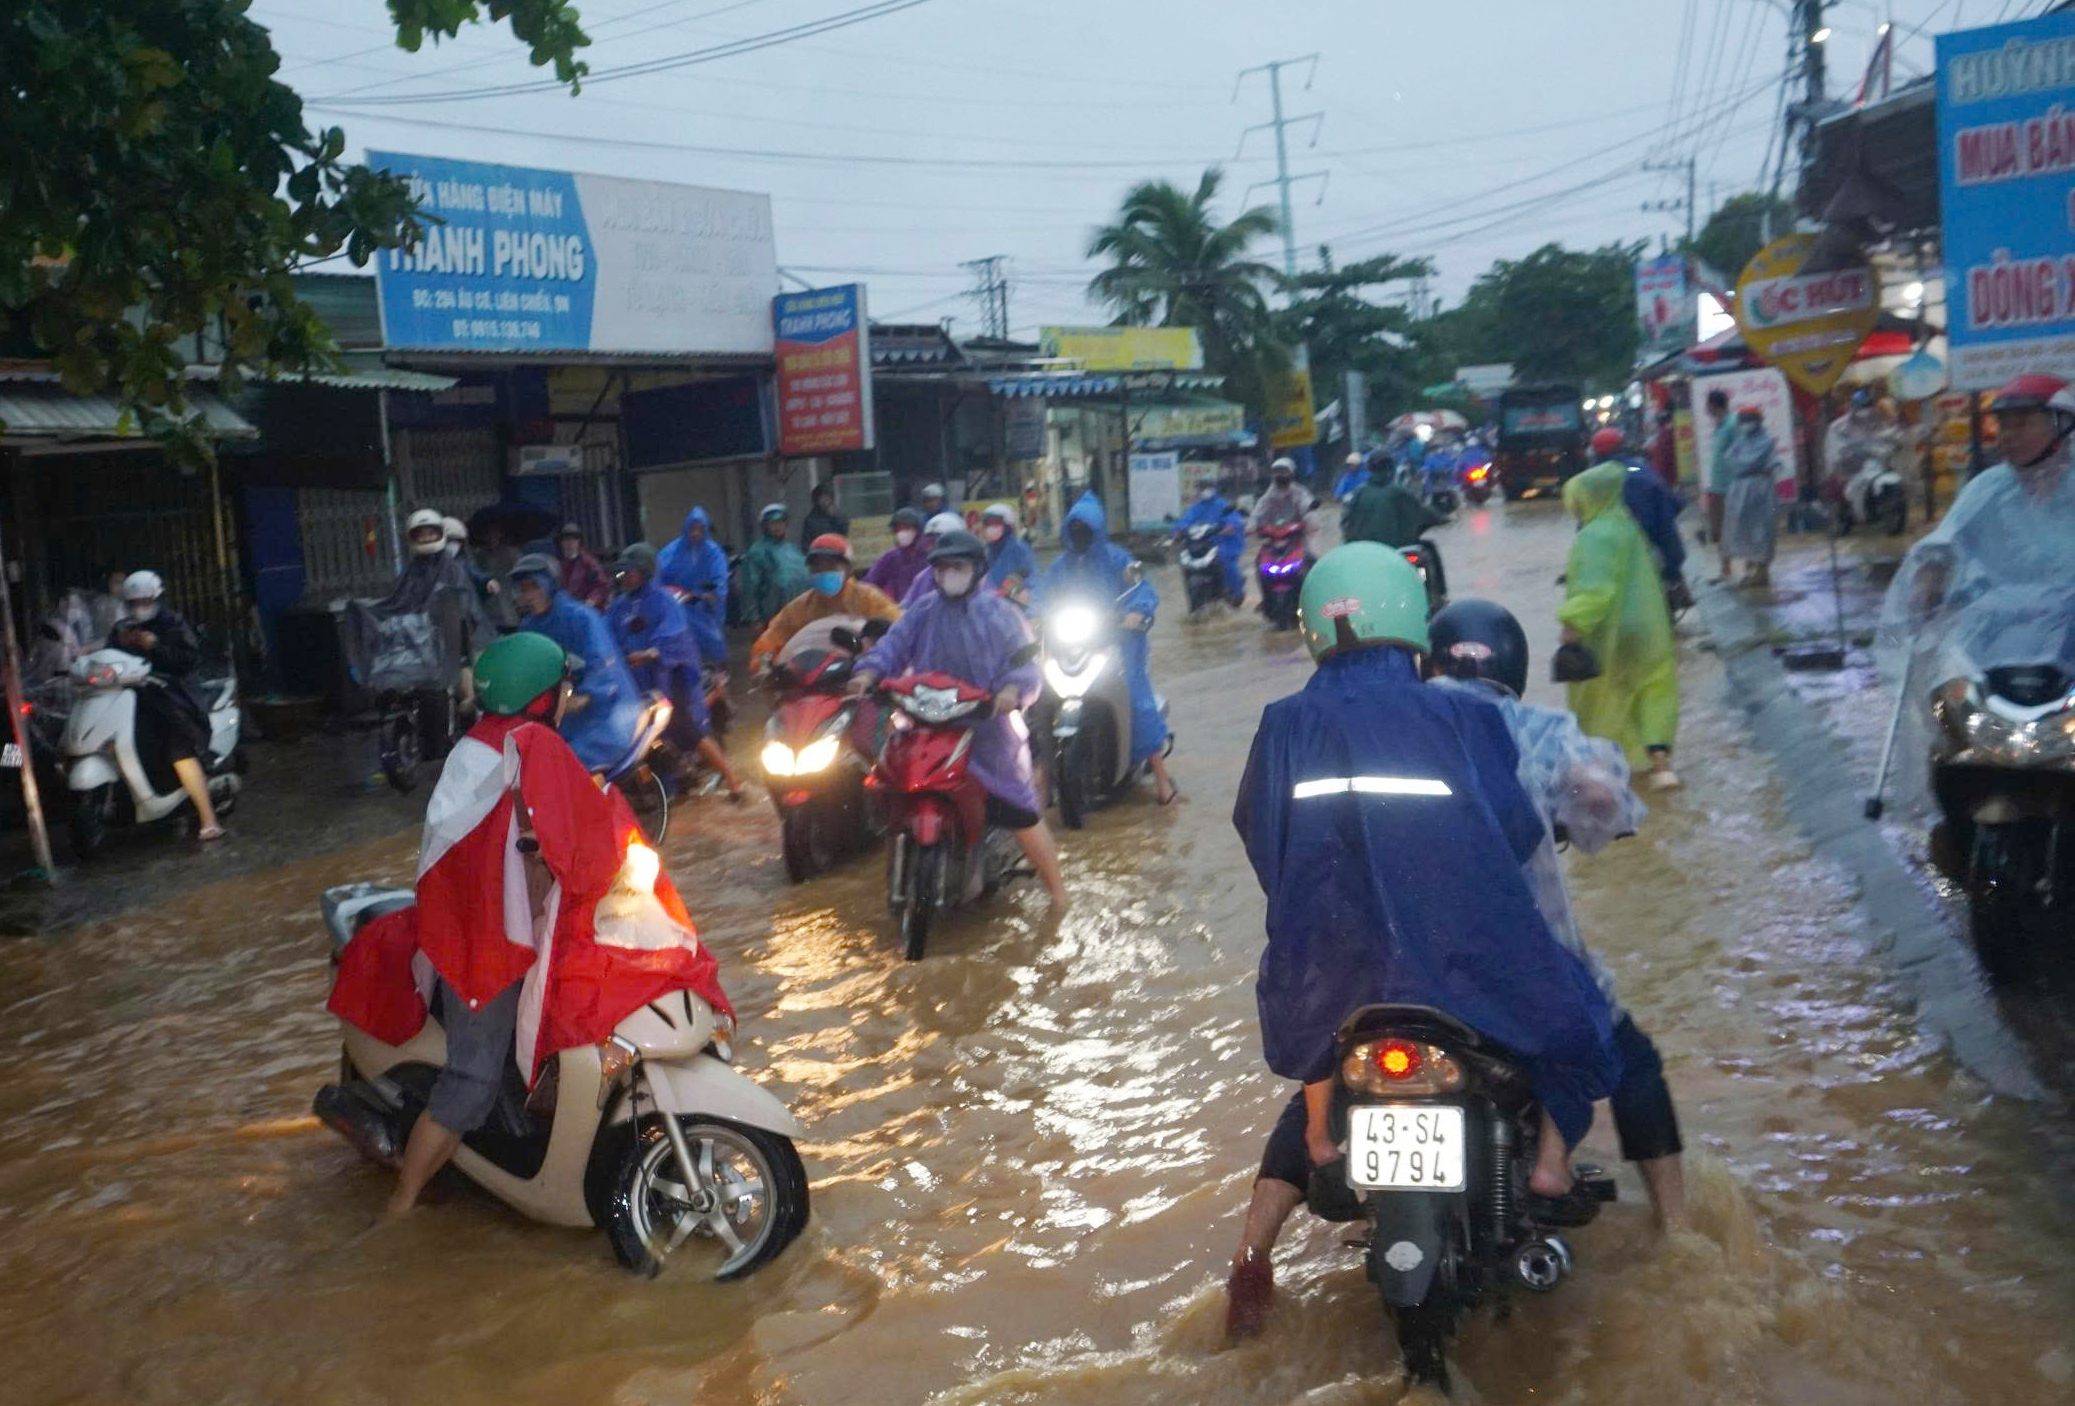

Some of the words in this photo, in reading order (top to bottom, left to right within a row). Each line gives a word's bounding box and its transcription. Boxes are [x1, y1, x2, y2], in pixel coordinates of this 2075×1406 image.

[1956, 122, 2019, 184] MUA
[402, 170, 434, 209] ỬA
[437, 176, 485, 212] HÀNG
[528, 186, 563, 219] MÁY
[493, 230, 584, 280] PHONG
[1366, 1112, 1445, 1145] 43-S4
[1366, 1150, 1446, 1184] 9794
